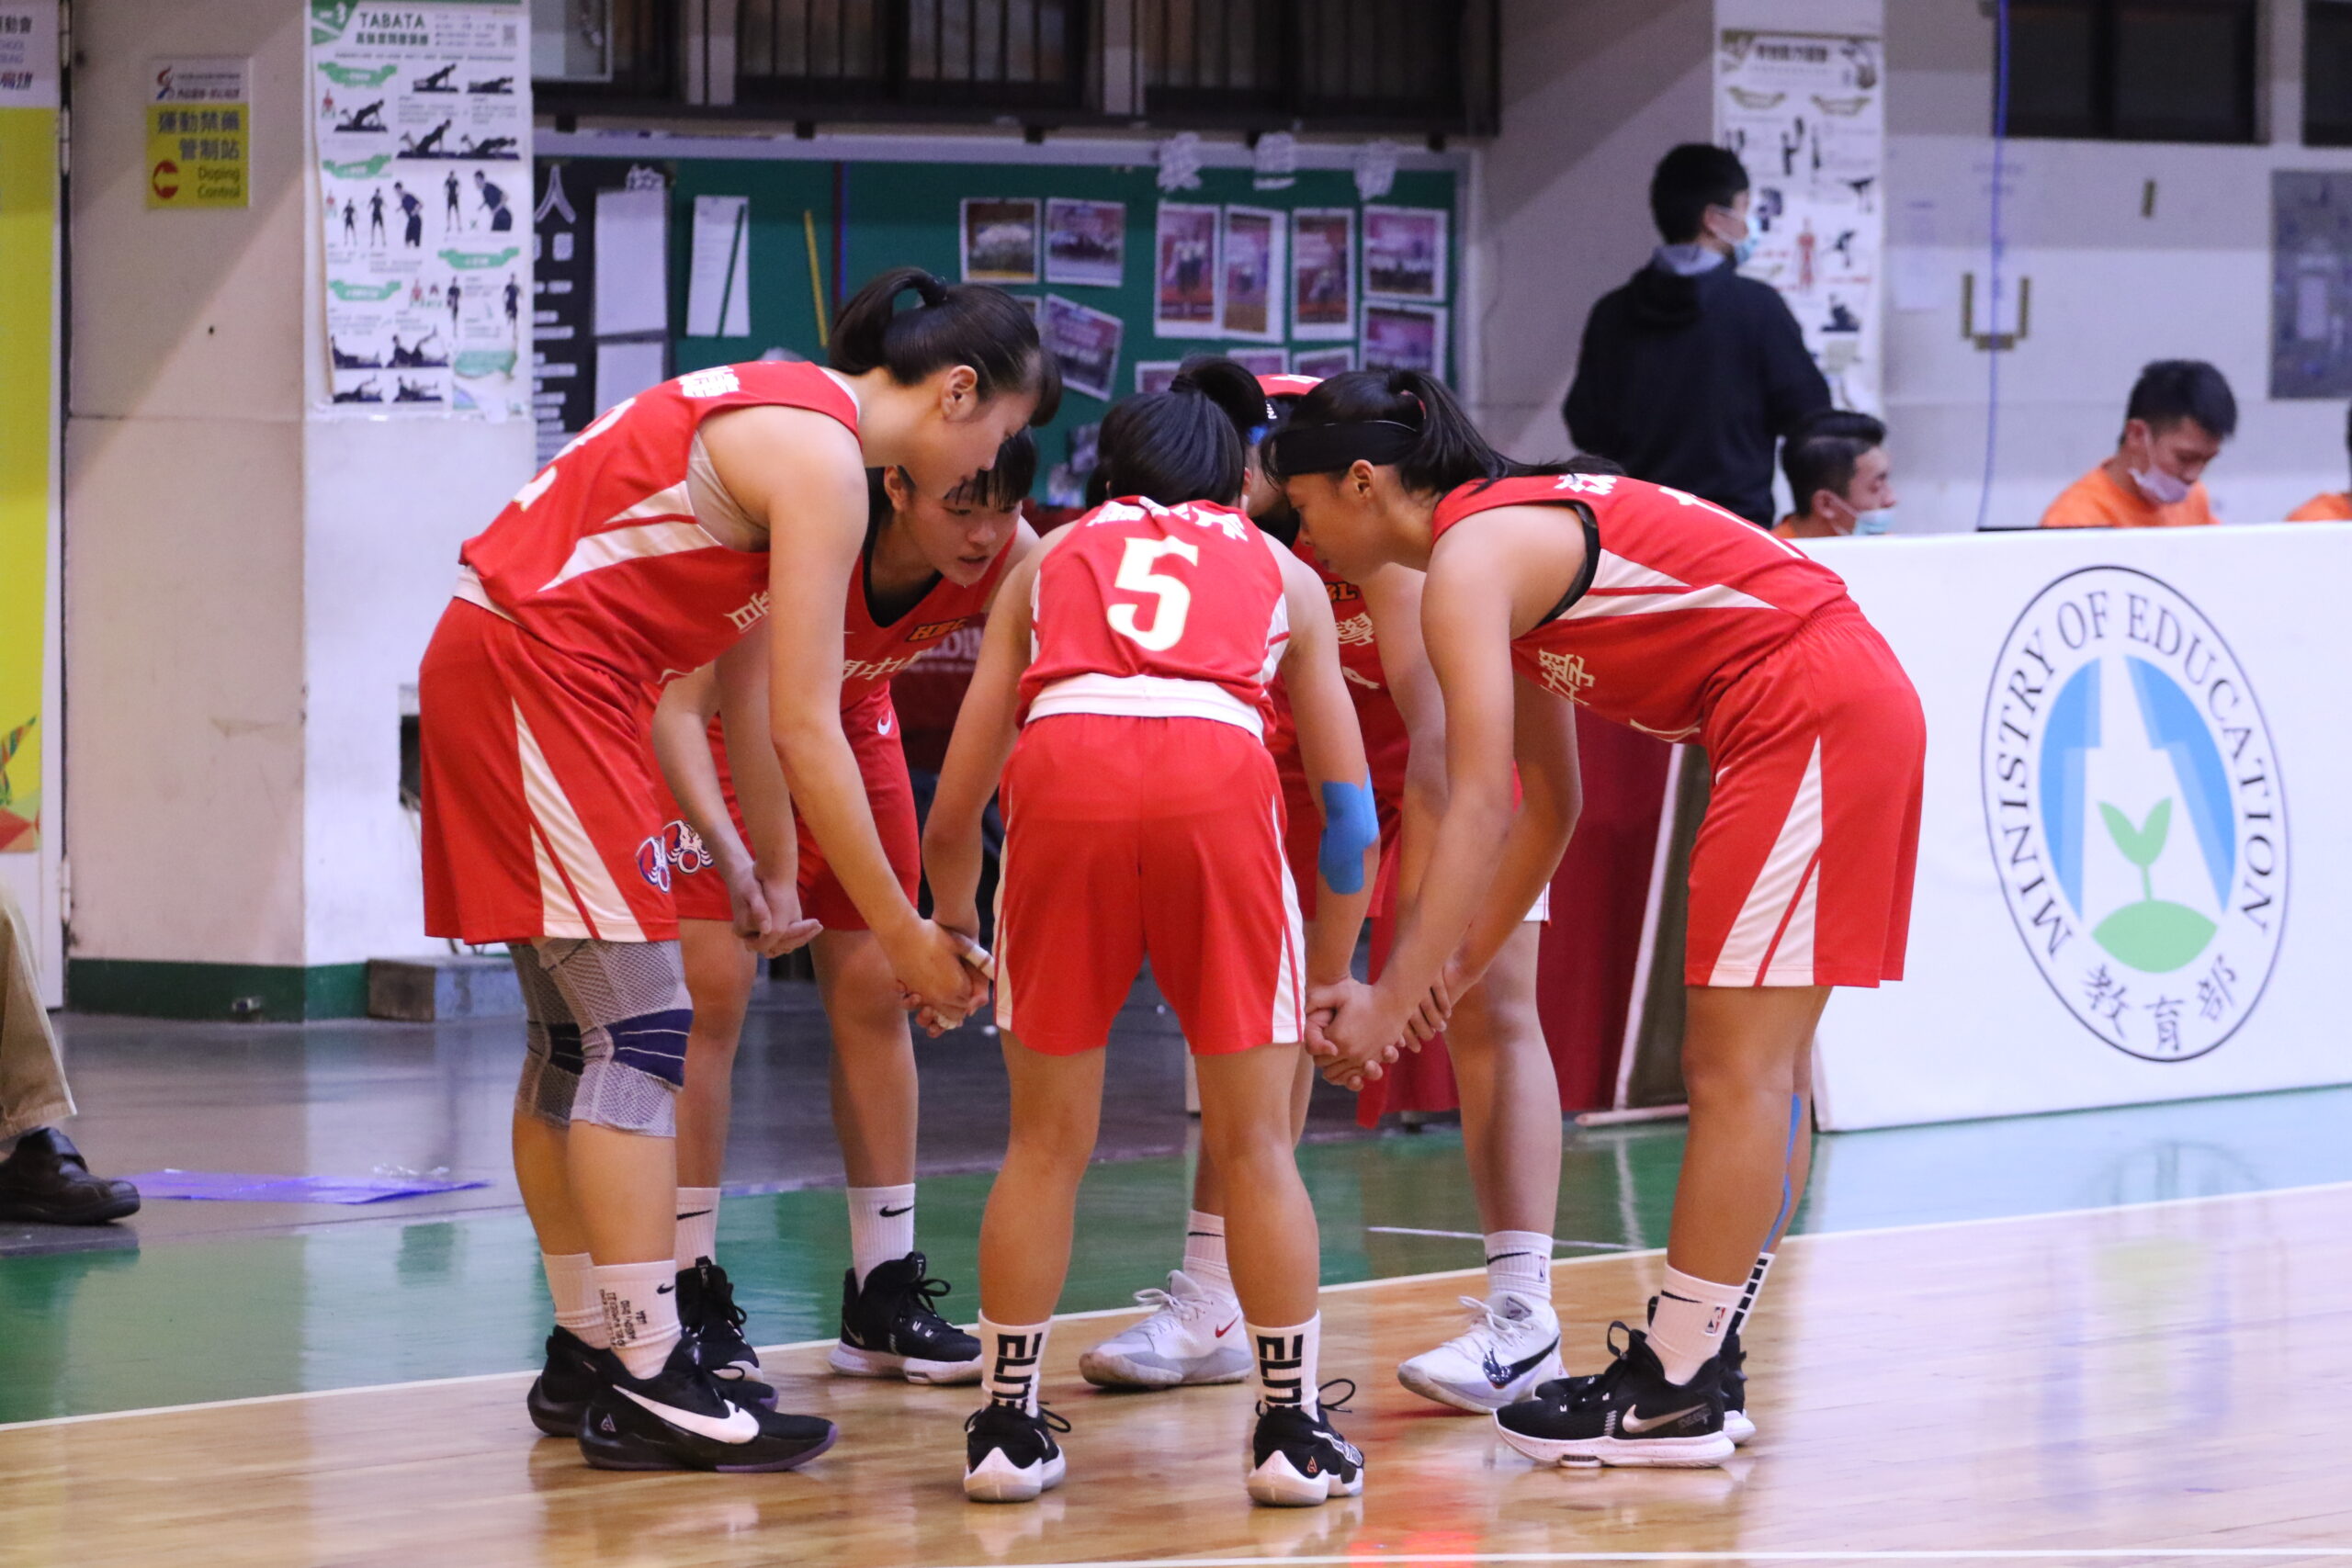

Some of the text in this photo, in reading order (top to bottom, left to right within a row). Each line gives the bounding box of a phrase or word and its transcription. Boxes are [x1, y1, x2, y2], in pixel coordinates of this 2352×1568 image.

[359, 13, 426, 29] TABATA
[198, 166, 241, 183] Doping
[198, 185, 241, 199] Control
[1107, 535, 1199, 652] 5
[1996, 590, 2276, 963] MINISTRY OF EDUCATION
[2081, 953, 2239, 1054] 教育部
